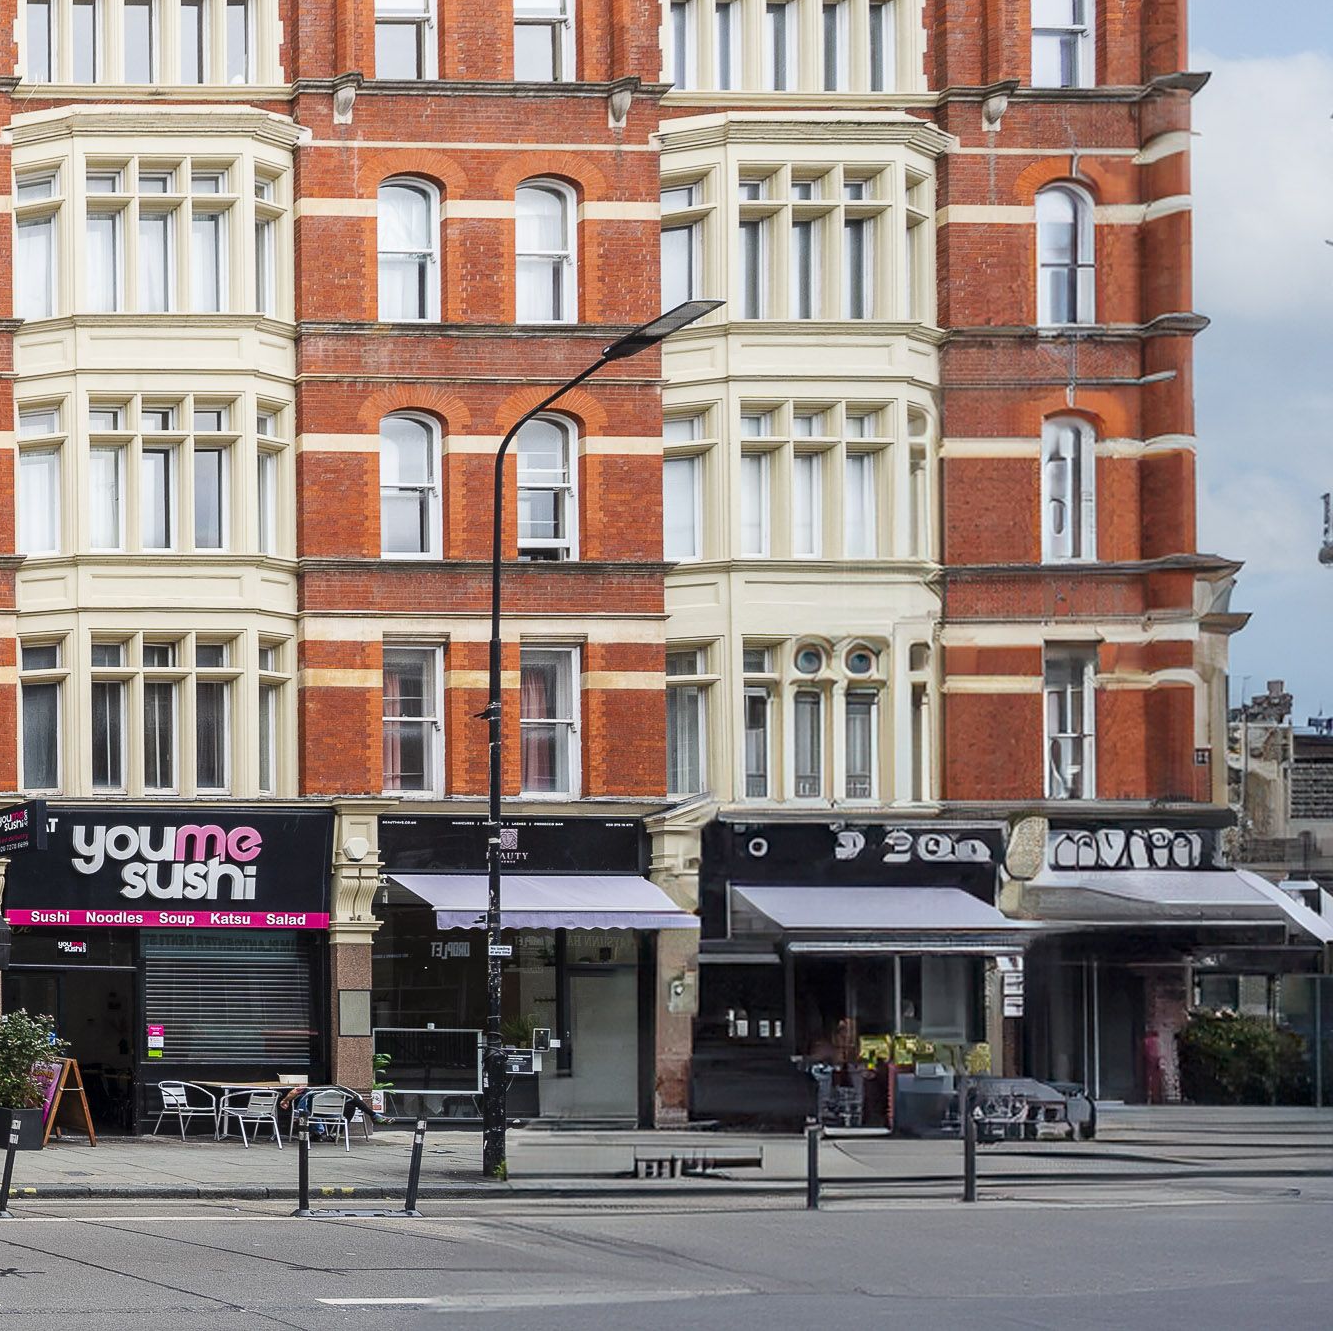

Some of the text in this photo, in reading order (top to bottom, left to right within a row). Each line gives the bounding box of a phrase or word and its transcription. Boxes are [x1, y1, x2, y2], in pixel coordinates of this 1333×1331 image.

[4, 819, 24, 831] sushi
[71, 824, 263, 875] youme
[486, 851, 529, 860] AUTY
[120, 855, 257, 900] sushi
[30, 910, 306, 926] Sushi Noodles Soup Katsu Salad
[57, 941, 83, 949] youme
[64, 945, 83, 953] sushi
